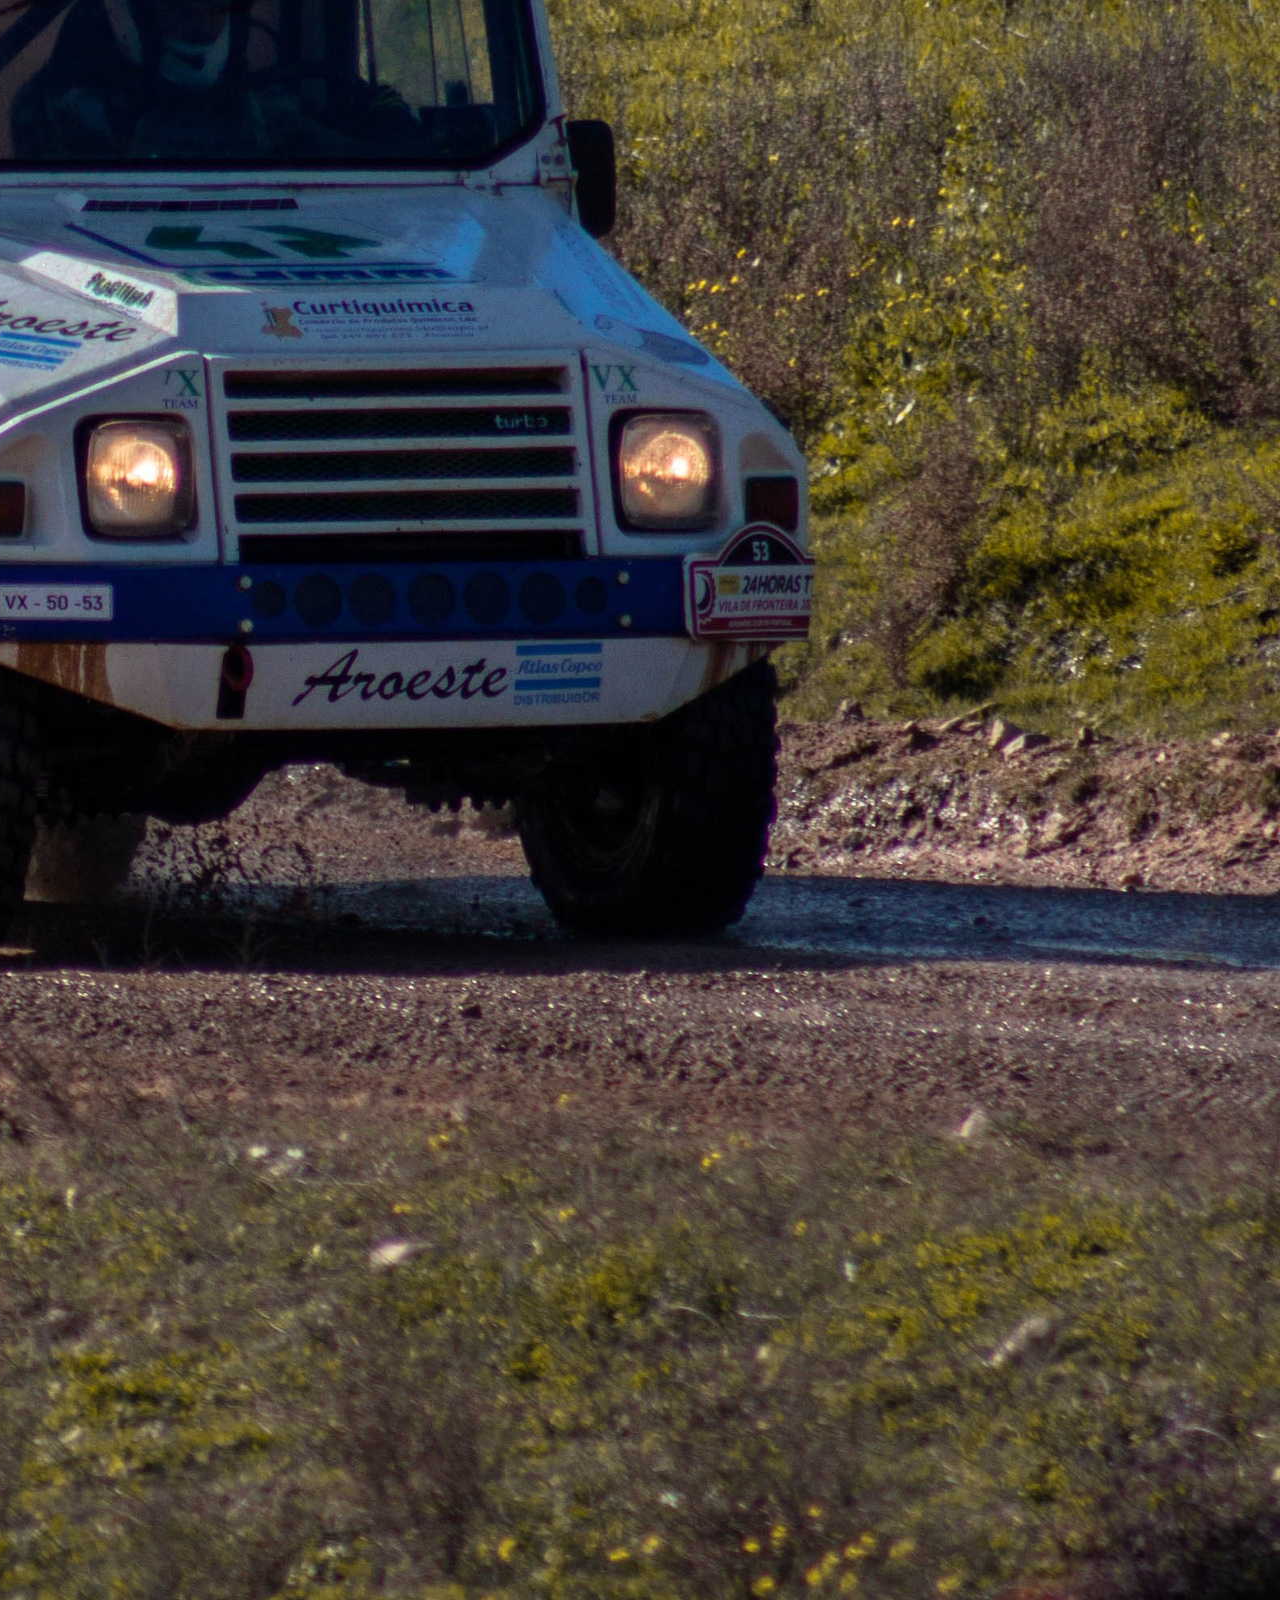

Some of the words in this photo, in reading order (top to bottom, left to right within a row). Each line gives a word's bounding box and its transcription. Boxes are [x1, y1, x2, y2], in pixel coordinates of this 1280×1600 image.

[293, 298, 474, 316] Curtiquímica
[588, 364, 640, 392] VX
[752, 541, 769, 562] 53
[804, 574, 815, 593] T
[719, 600, 738, 612] VILA
[740, 600, 750, 612] DE
[752, 599, 799, 612] FRONTEIRA
[517, 659, 559, 674] Atlas
[560, 658, 603, 676] Copco
[291, 648, 508, 707] Aroeste
